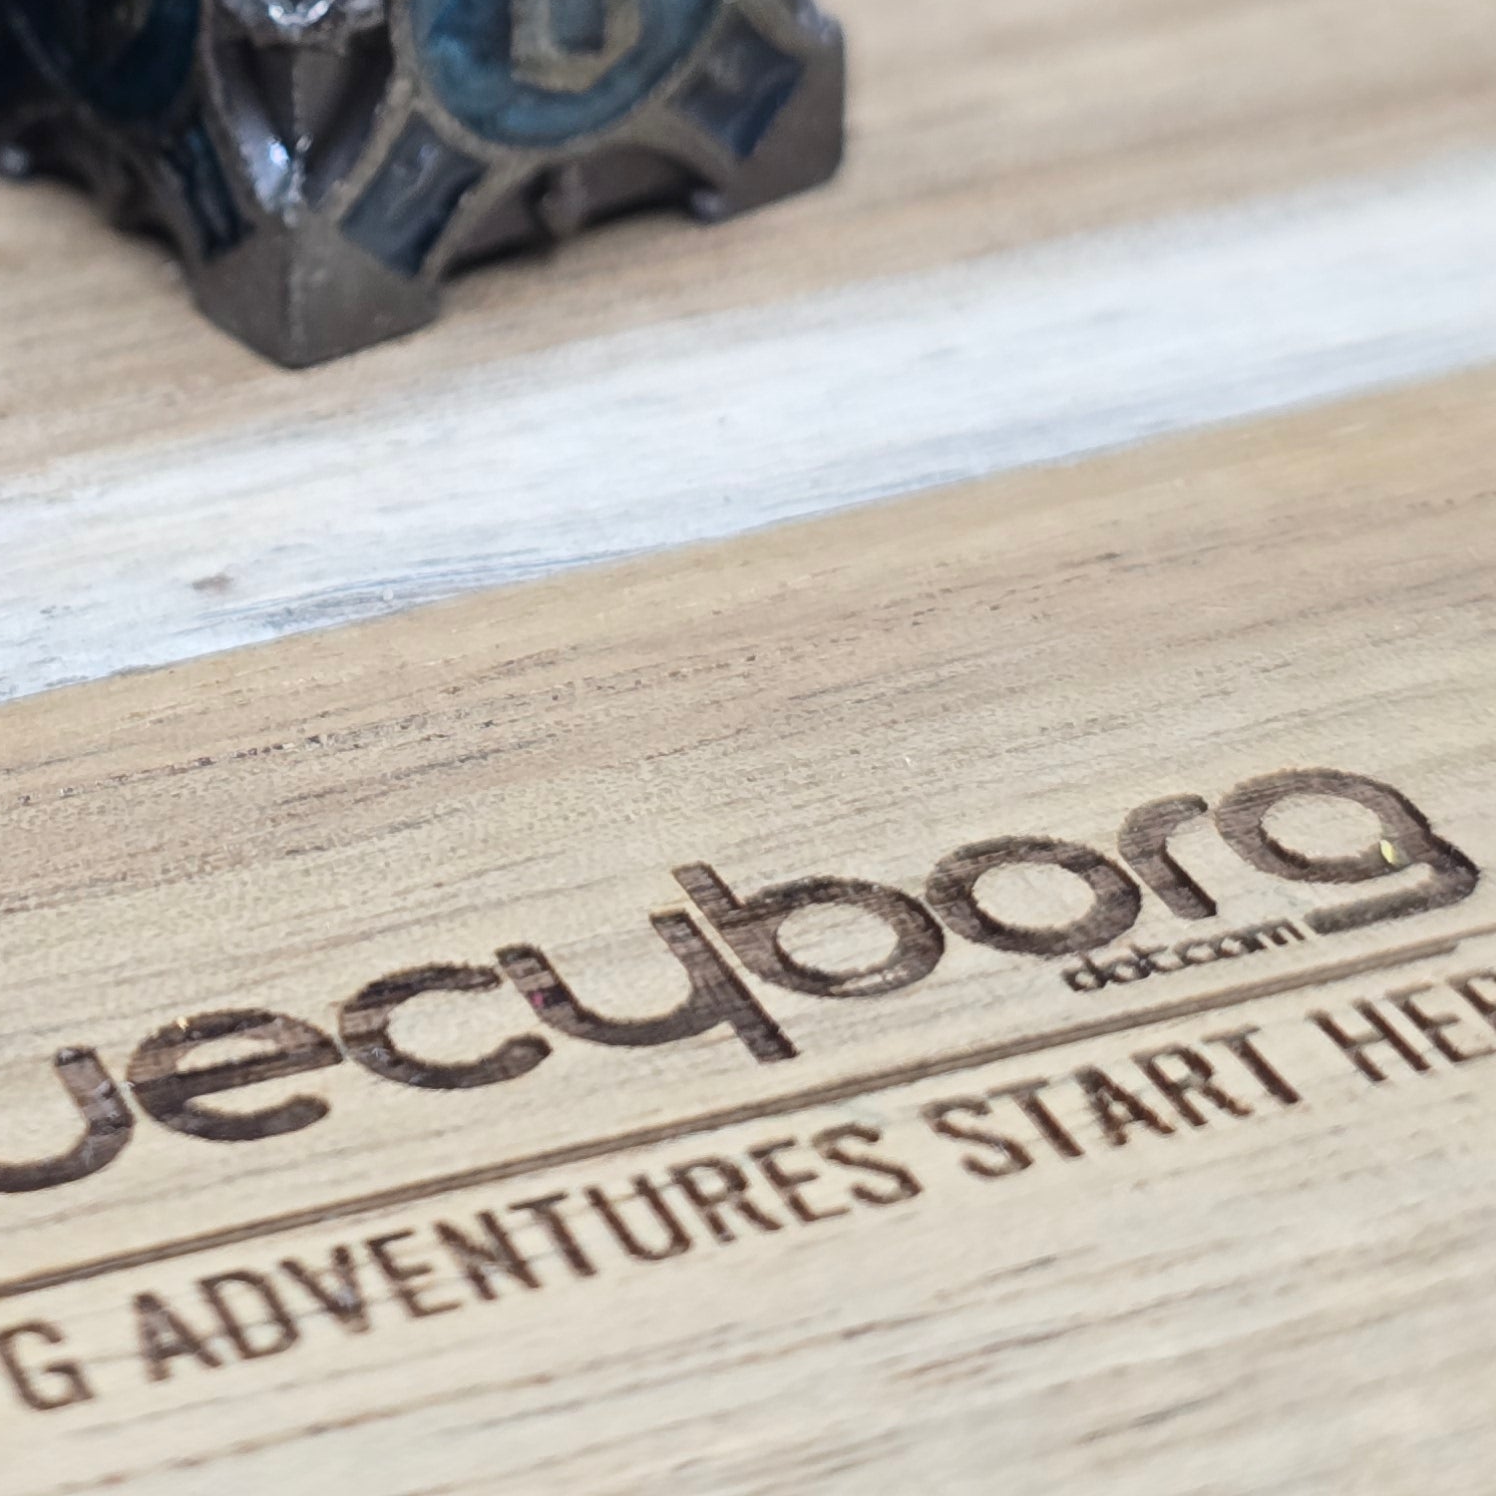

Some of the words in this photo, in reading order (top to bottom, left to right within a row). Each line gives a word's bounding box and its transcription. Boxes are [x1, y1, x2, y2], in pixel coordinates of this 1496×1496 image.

[1060, 918, 1306, 992] dotcom
[131, 1121, 924, 1383] ADVENTURES
[924, 1024, 1301, 1180] START
